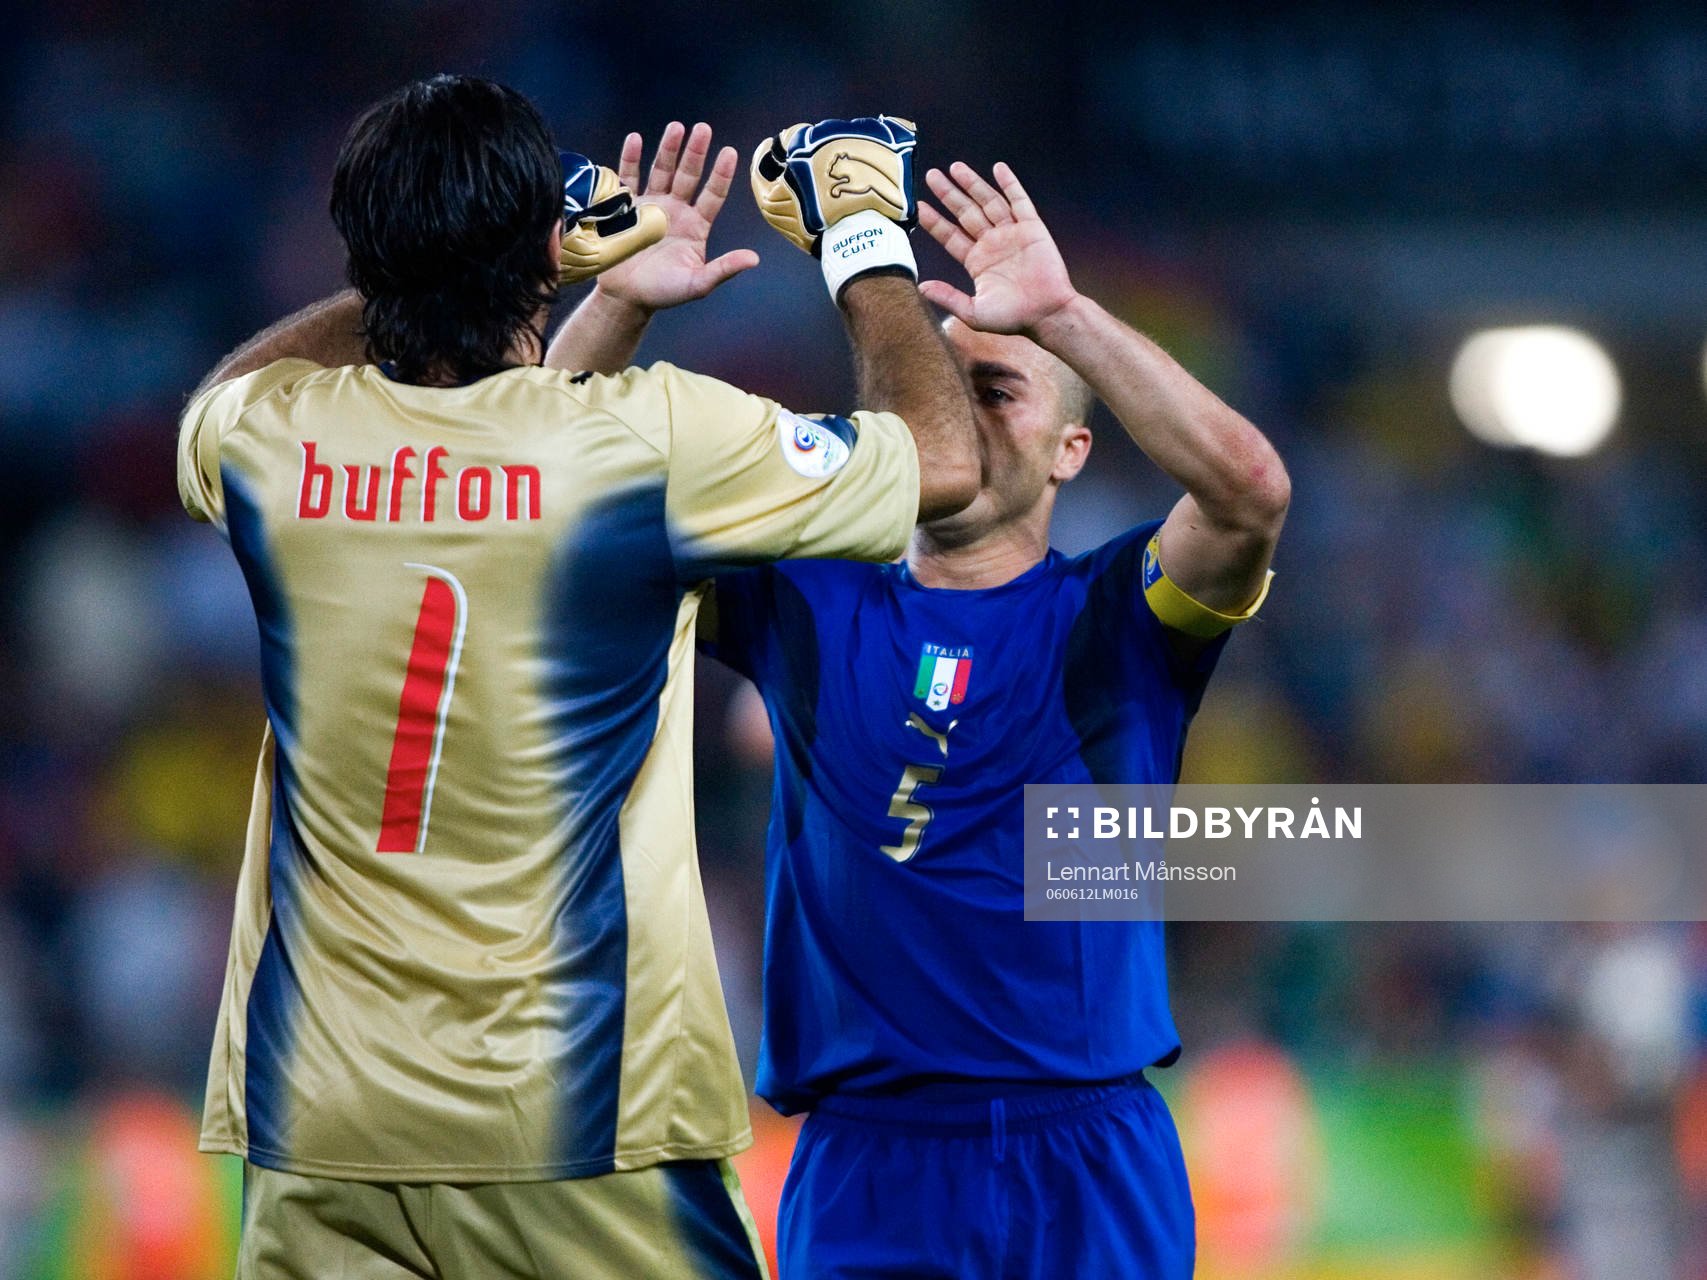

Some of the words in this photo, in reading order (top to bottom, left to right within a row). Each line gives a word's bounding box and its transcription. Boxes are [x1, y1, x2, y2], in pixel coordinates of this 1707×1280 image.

[832, 228, 883, 253] BUFFON
[297, 441, 541, 522] buffon
[926, 644, 970, 658] ITALIA
[376, 562, 468, 855] 1
[879, 763, 945, 863] 5
